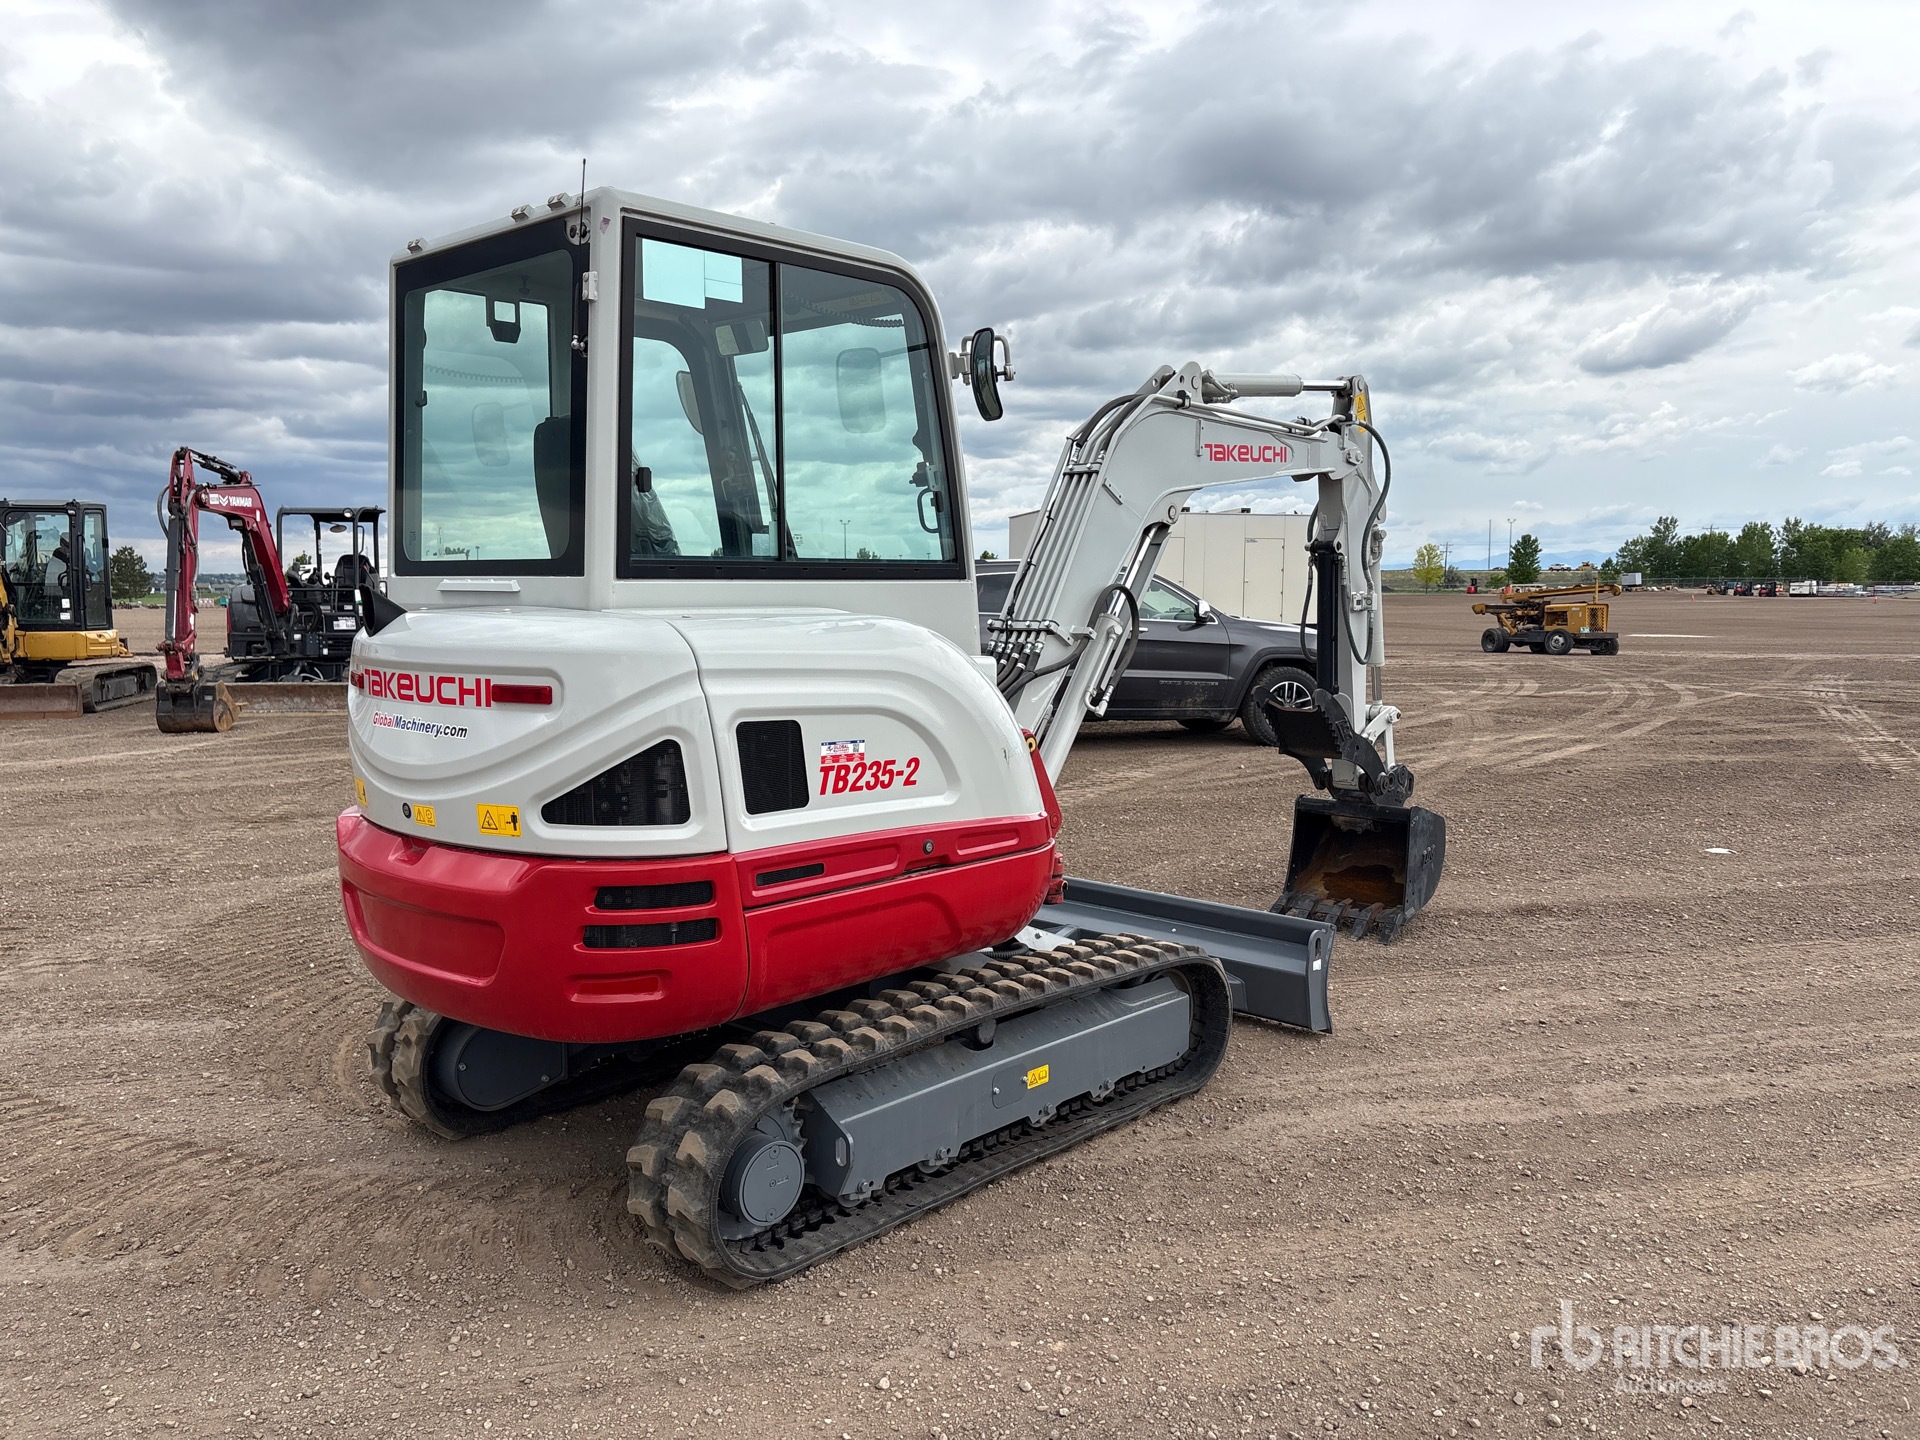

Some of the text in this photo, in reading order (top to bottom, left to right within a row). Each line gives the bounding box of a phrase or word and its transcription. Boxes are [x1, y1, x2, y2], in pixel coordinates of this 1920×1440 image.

[1204, 443, 1288, 464] TAKEUCHI
[229, 496, 253, 507] YANMAR
[364, 668, 492, 708] TAKEUCHI
[373, 711, 468, 738] GlobalMachinery.com
[819, 757, 920, 796] TB235-2
